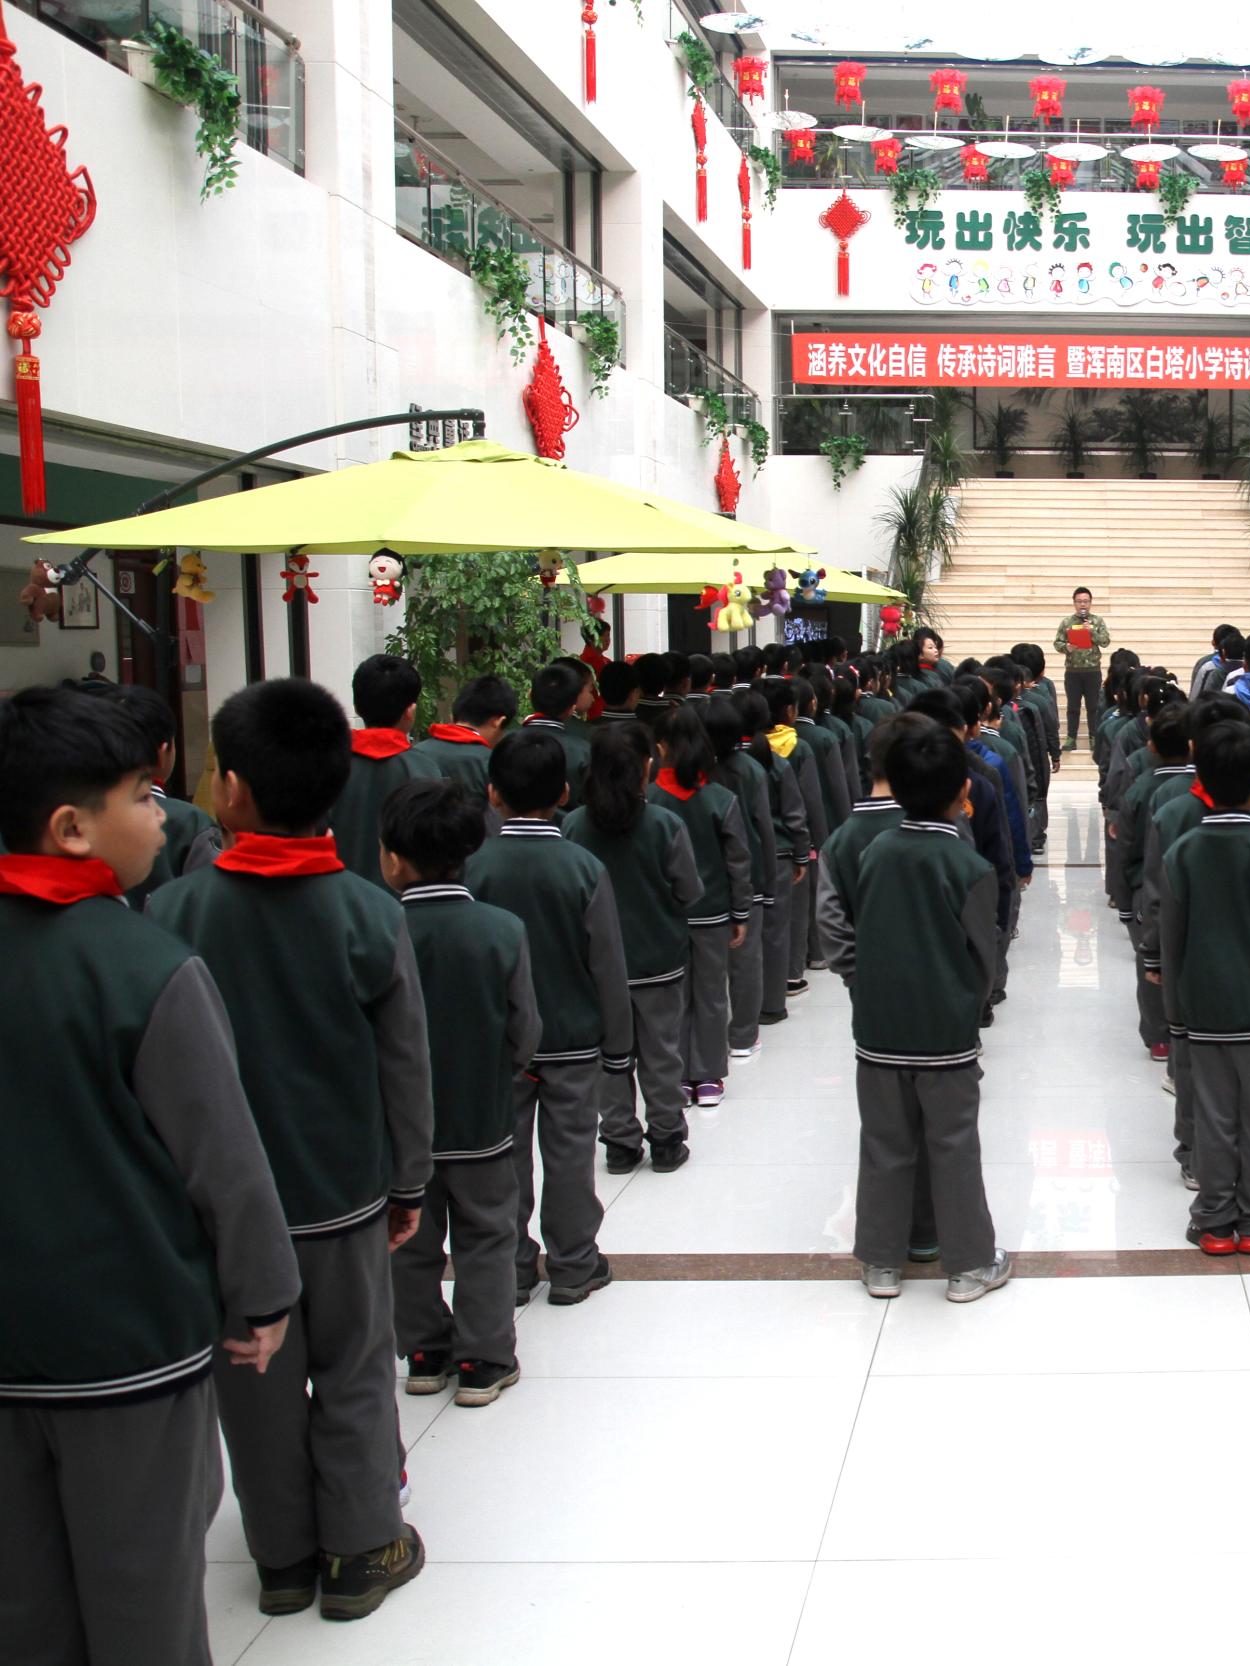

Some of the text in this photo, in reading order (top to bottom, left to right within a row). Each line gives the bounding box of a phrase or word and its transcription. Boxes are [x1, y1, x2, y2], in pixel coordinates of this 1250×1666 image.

[905, 210, 1090, 252] 玩出快乐
[808, 343, 927, 377] 涵养文化自信
[937, 344, 1056, 378] 传承诗词雅言
